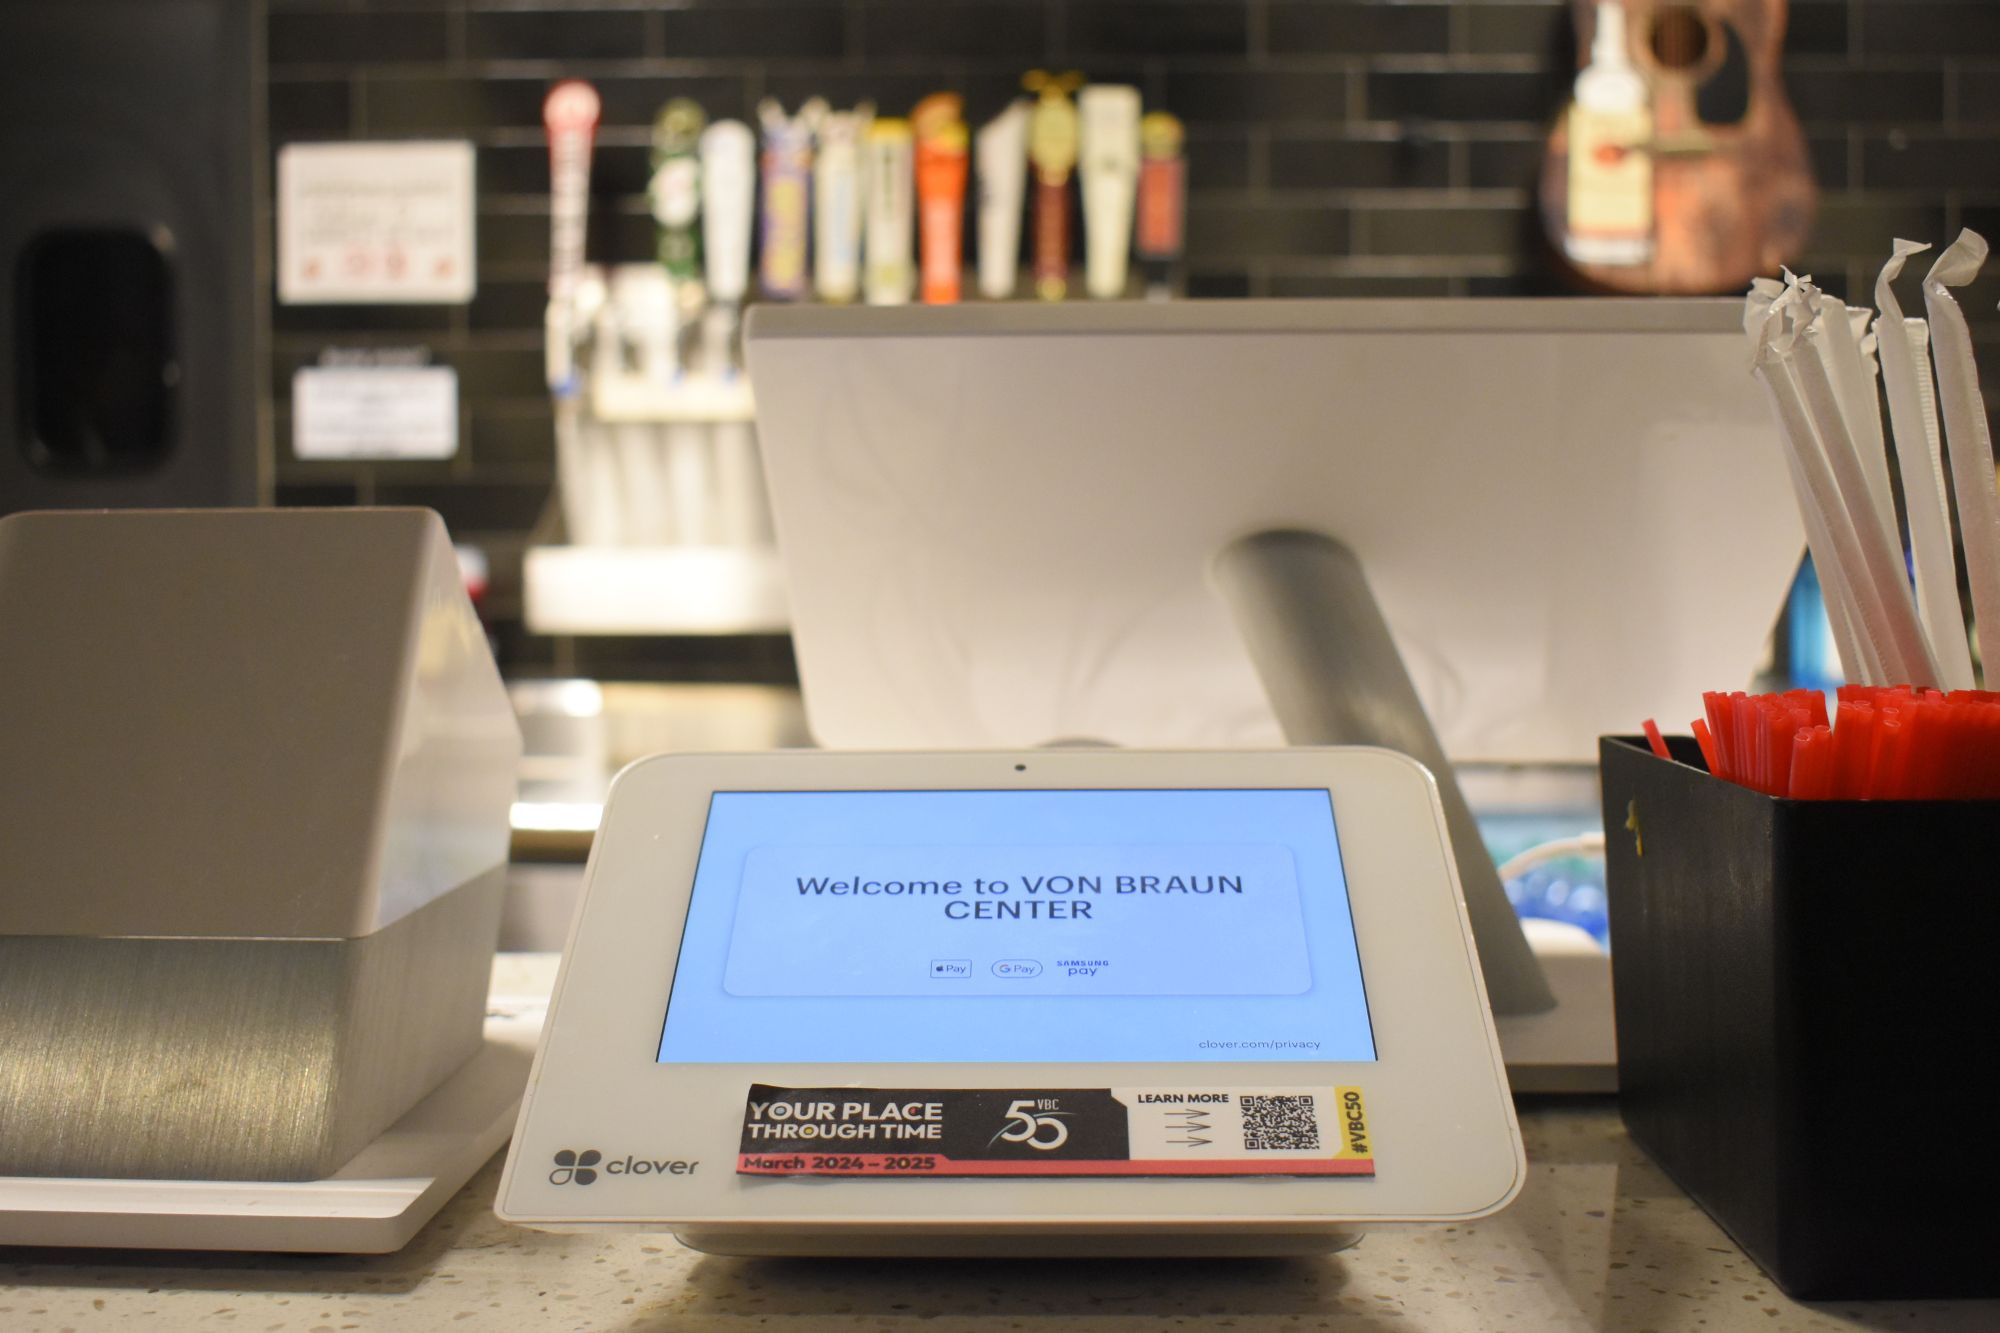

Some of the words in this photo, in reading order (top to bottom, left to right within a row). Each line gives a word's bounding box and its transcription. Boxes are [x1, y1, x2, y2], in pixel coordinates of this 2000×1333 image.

[797, 876, 962, 895] Welcome
[974, 878, 1009, 895] to
[1021, 876, 1101, 894] VON
[1116, 876, 1243, 894] BRAUN
[944, 900, 1093, 920] CENTER
[946, 965, 967, 974] Pay
[1014, 965, 1036, 975] Pay
[1068, 967, 1098, 976] pay
[1198, 1040, 1321, 1050] clover.com/privacy
[1037, 1099, 1059, 1110] VBC
[1138, 1094, 1184, 1103] LEARN
[1187, 1094, 1230, 1103] MORE
[749, 1102, 836, 1121] YOUR
[842, 1102, 943, 1120] PLACE
[1344, 1091, 1368, 1154] #VBC50
[748, 1123, 875, 1139] THROUGH
[880, 1123, 942, 1139] TIME
[606, 1156, 699, 1174] clover
[744, 1156, 805, 1170] March
